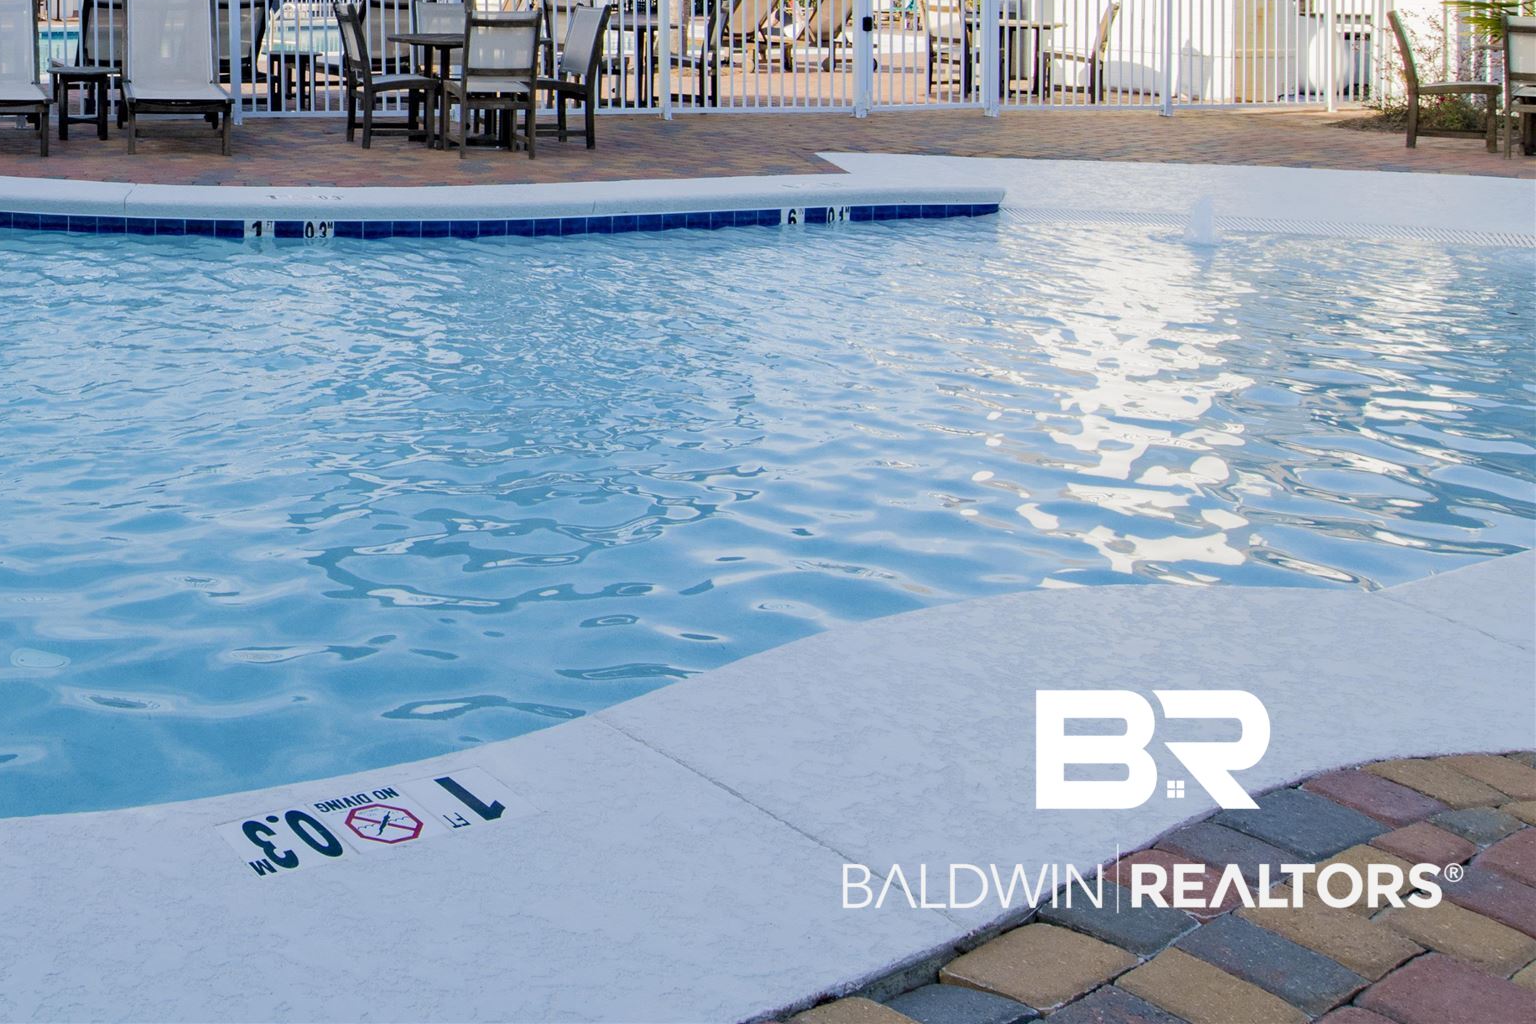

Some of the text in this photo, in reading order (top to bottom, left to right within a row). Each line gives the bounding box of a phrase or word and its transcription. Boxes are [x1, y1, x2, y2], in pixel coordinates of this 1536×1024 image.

[787, 208, 797, 224] 6
[251, 220, 262, 237] 1
[314, 787, 400, 814] NO DIVING
[434, 776, 506, 821] 1
